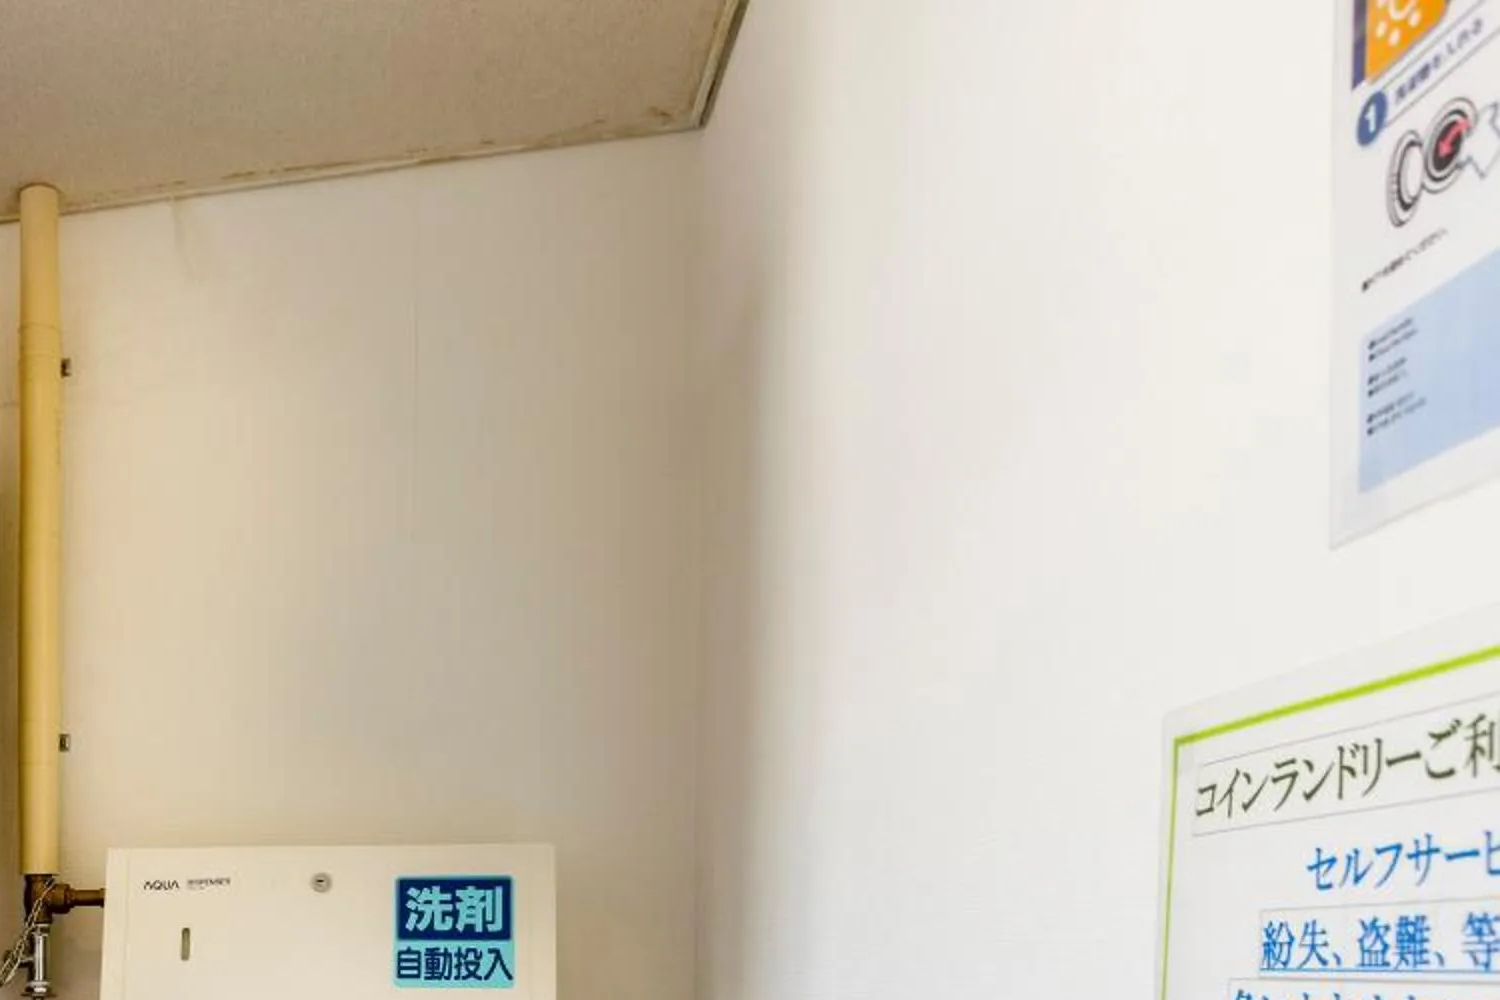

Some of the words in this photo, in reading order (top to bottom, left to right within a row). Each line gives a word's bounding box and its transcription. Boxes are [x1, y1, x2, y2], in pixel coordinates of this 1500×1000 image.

[1196, 713, 1500, 818] コインランドリーご利
[143, 879, 180, 890] AQUA
[404, 885, 504, 934] 洗剤
[396, 946, 514, 982] 自動投入
[1261, 912, 1500, 971] 紛失、盗難、等
